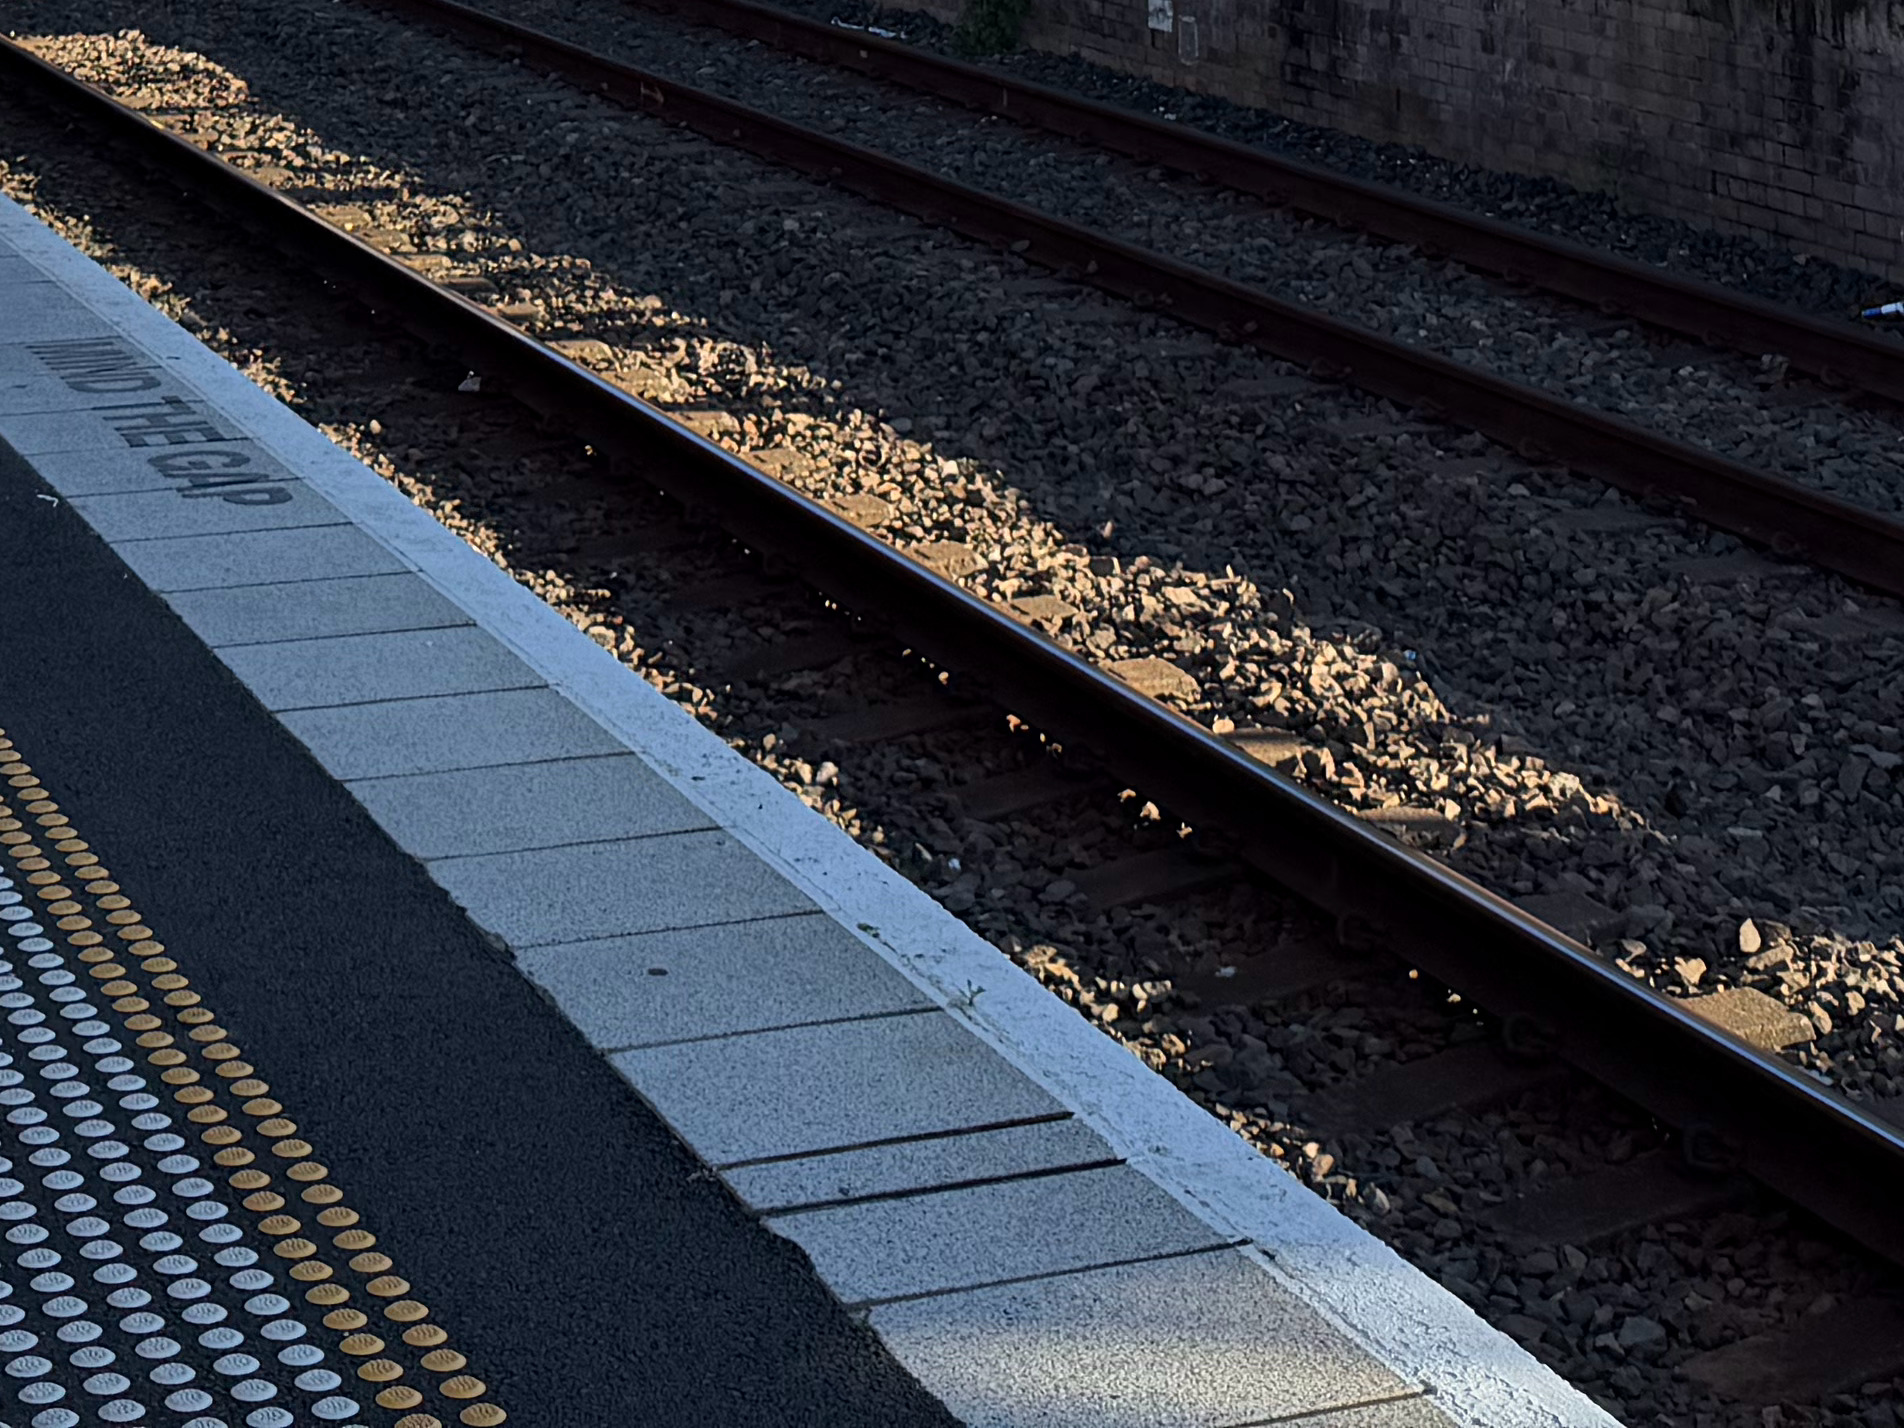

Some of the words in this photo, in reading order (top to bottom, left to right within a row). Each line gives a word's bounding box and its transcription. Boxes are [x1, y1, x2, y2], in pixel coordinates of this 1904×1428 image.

[24, 341, 162, 393] MIND
[91, 395, 225, 448] THE
[147, 450, 293, 506] GAP
